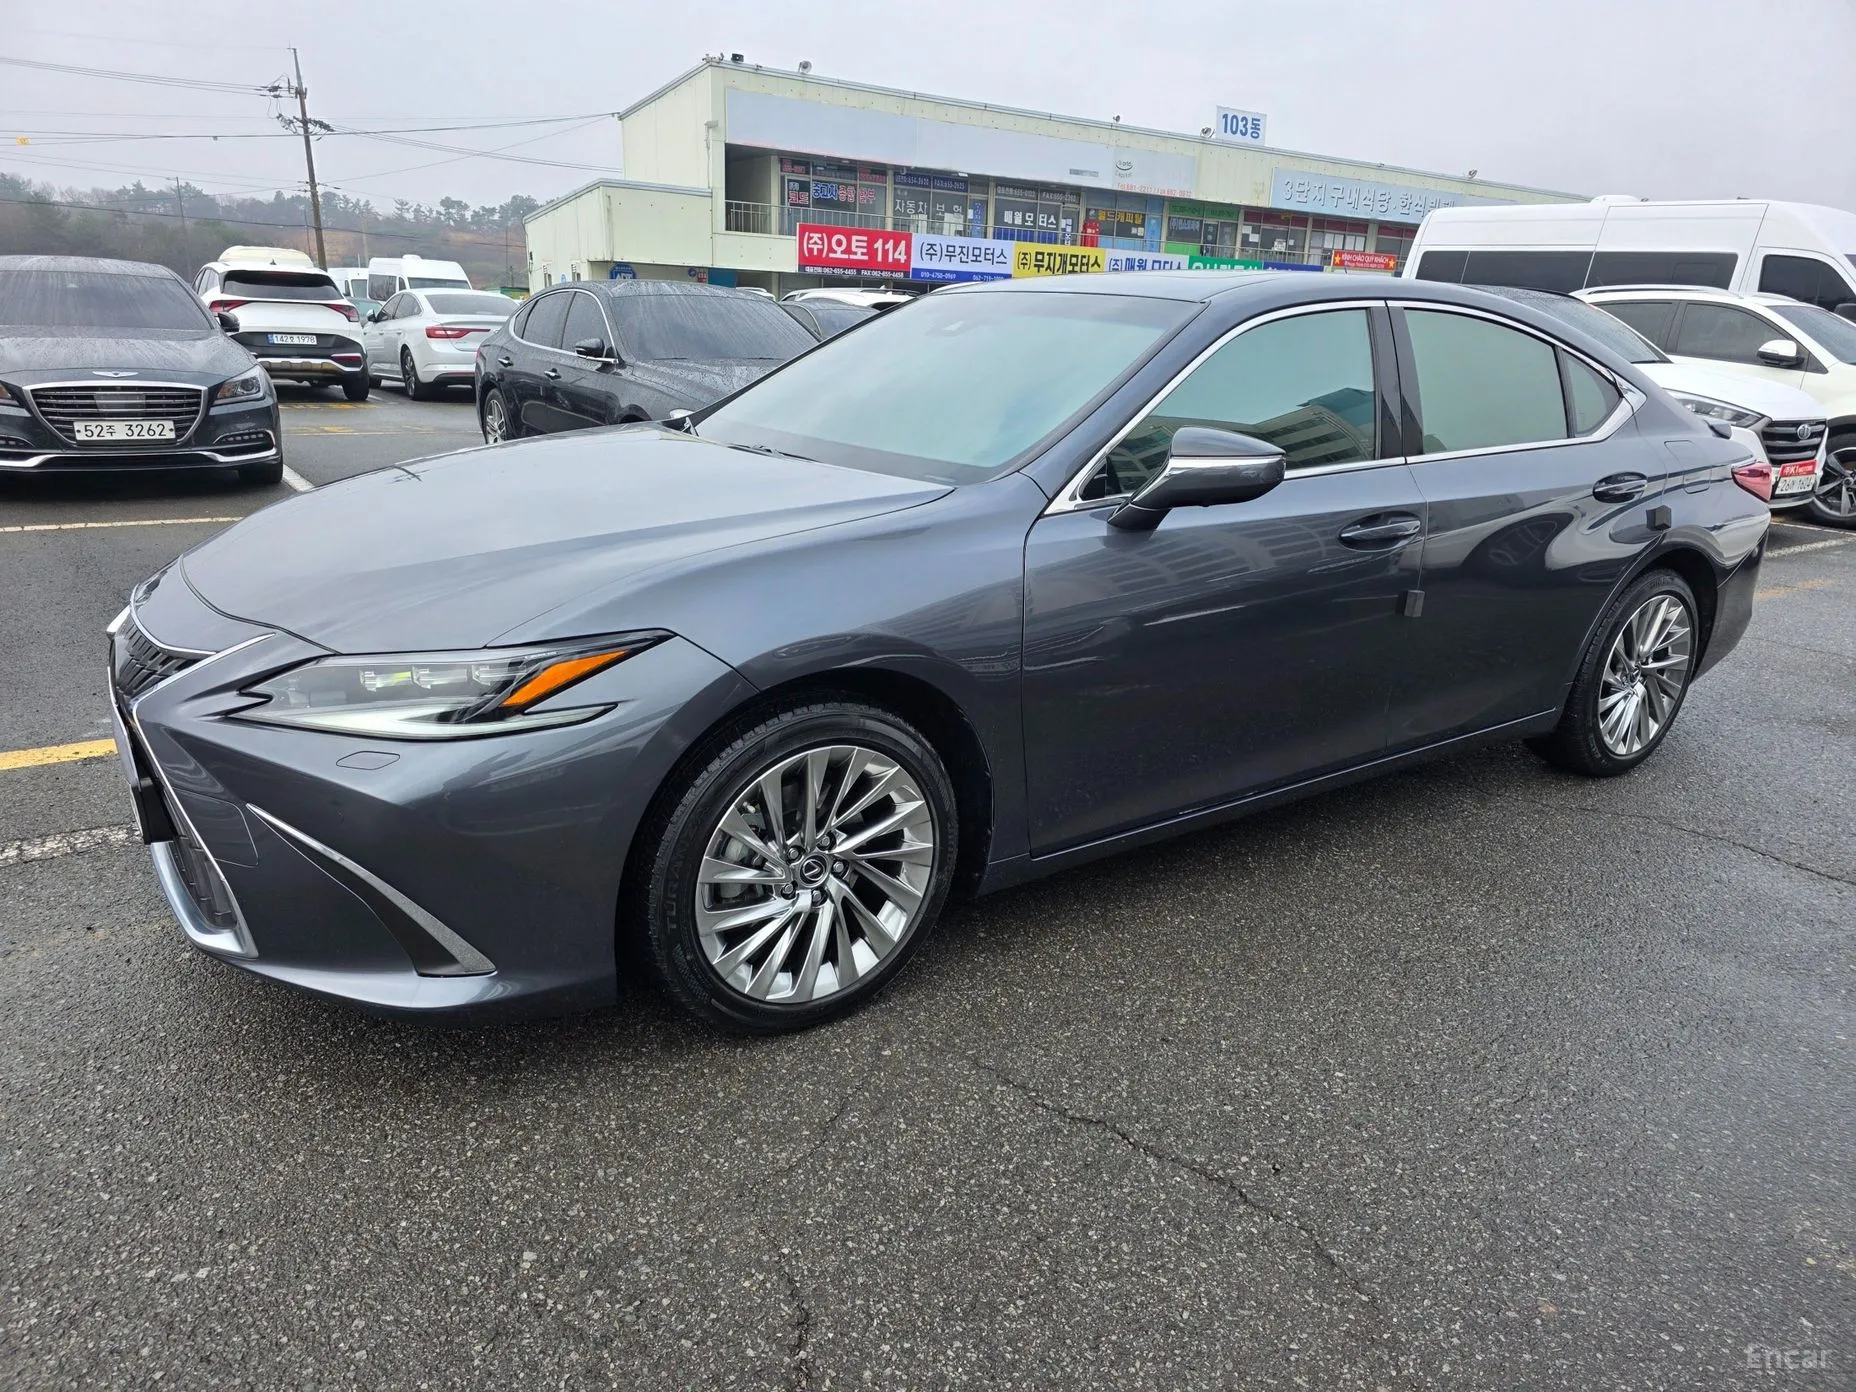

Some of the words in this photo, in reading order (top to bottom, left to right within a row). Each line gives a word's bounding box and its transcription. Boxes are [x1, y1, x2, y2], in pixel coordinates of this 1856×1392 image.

[1221, 113, 1261, 139] 103동
[1285, 178, 1327, 207] 3단지
[894, 199, 928, 216] 자동차
[803, 231, 870, 261] (주)오토
[873, 238, 907, 263] 114
[920, 241, 1008, 266] (주)무진모터스
[83, 424, 117, 438] 52주
[124, 423, 167, 438] 3262
